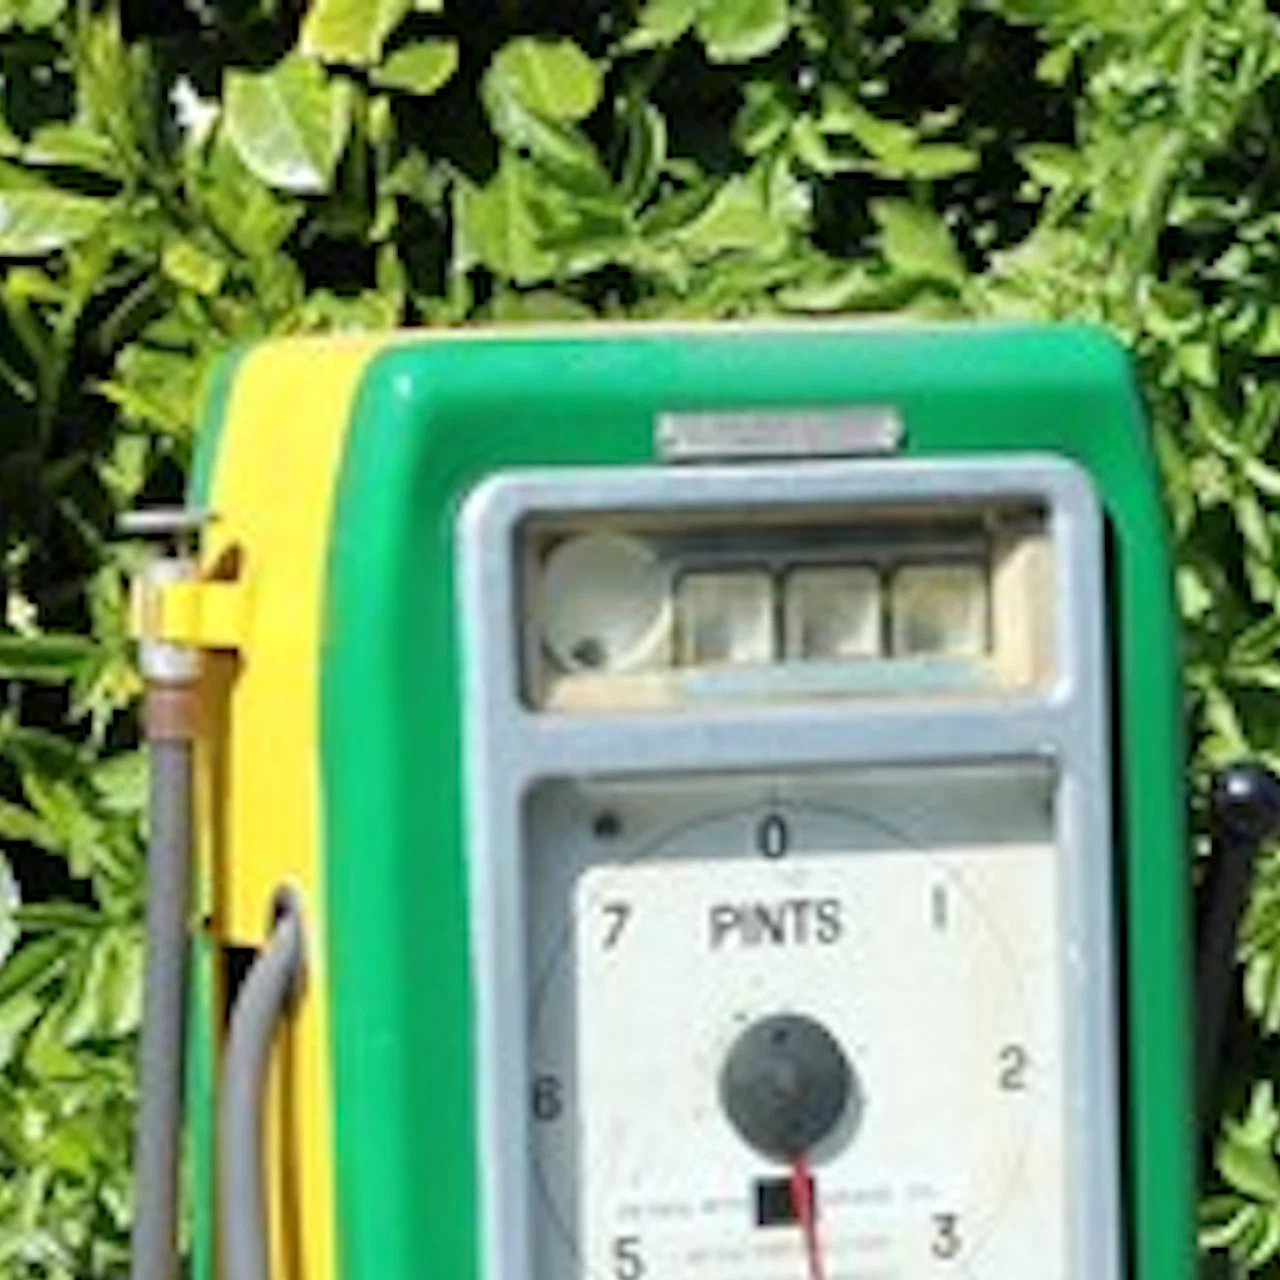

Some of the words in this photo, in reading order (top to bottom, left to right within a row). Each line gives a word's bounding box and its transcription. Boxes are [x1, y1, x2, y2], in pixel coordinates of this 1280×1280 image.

[757, 813, 789, 860] 0
[601, 902, 634, 949] 7
[708, 898, 844, 949] PINTS
[998, 1044, 1029, 1091] 2
[532, 1075, 563, 1123] 6
[930, 1213, 962, 1259] 3
